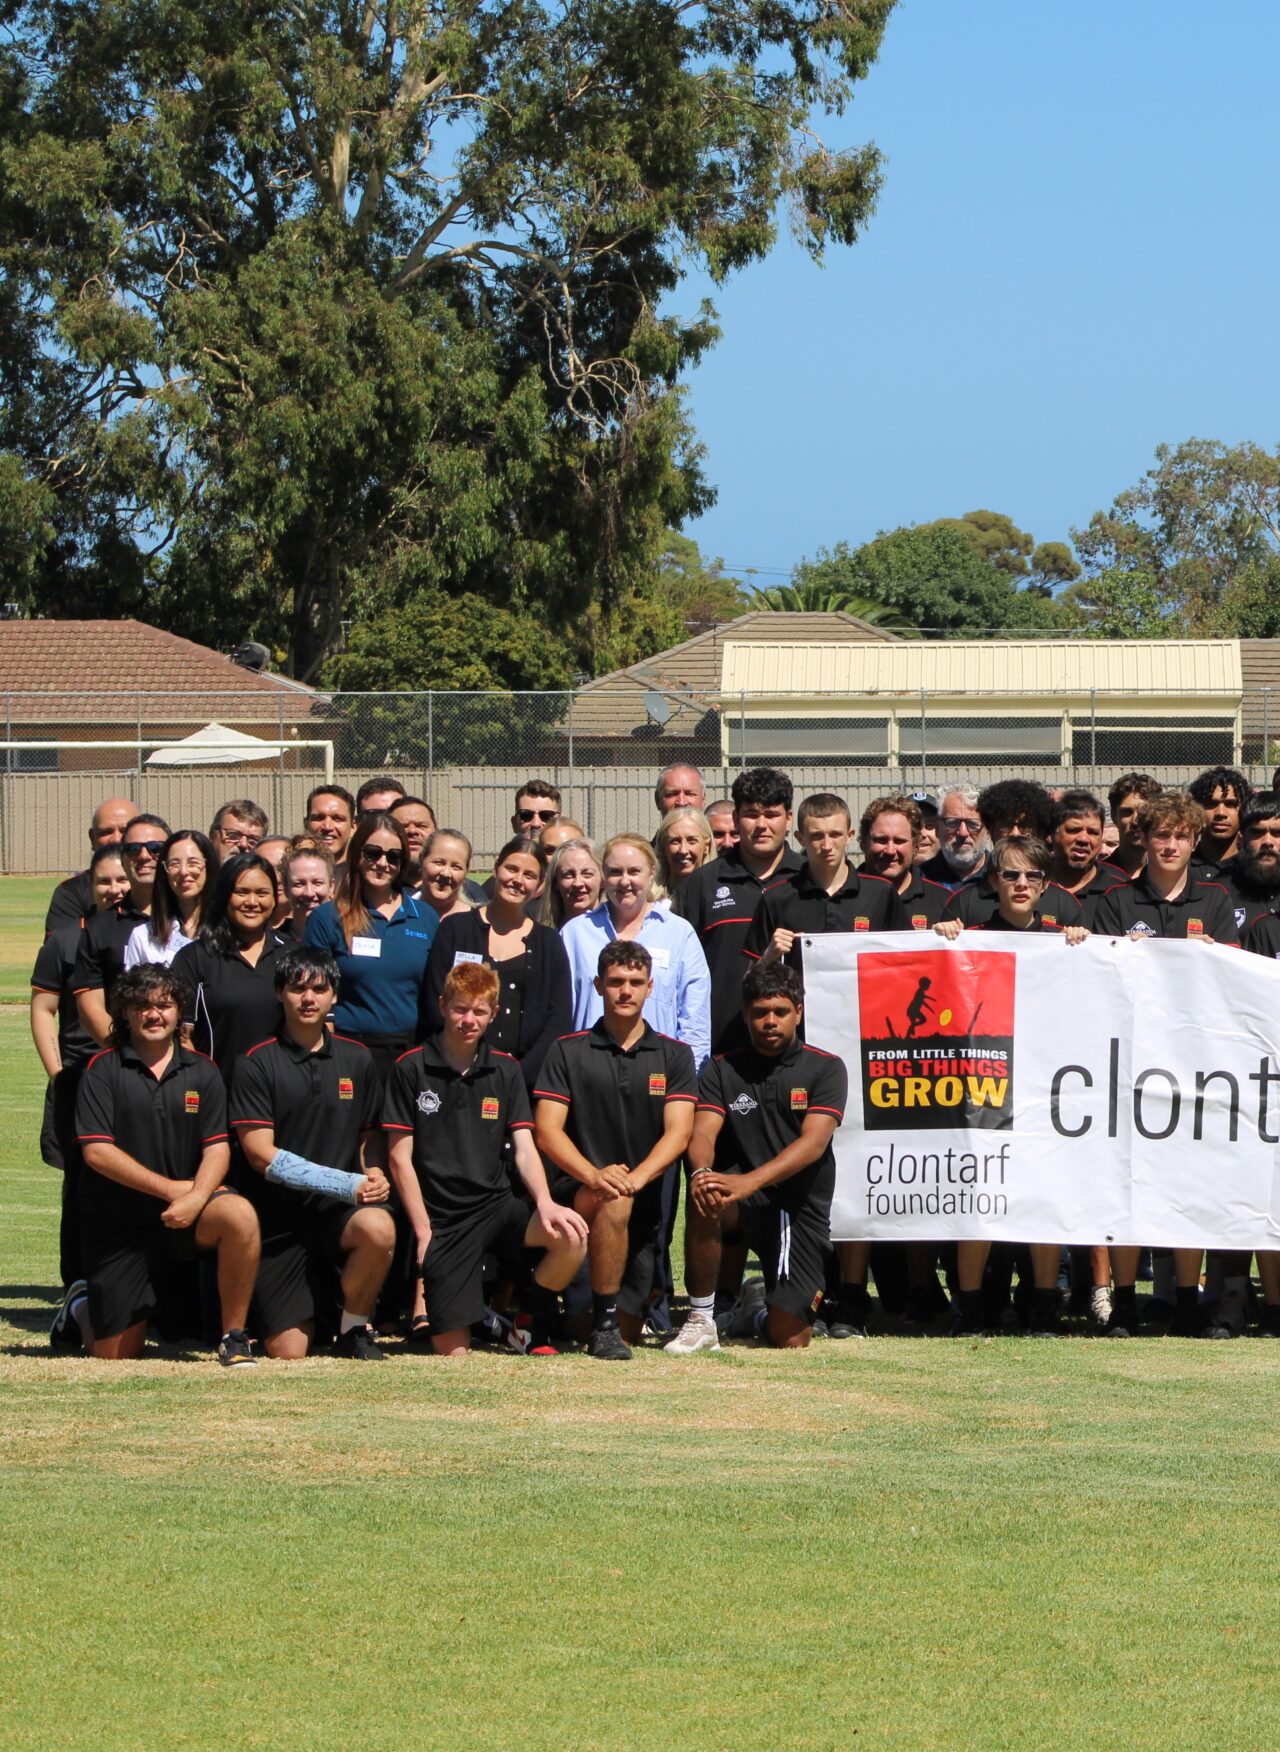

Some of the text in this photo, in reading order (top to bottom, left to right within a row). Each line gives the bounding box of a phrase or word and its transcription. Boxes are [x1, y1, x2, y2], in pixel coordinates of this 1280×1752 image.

[868, 1048, 1008, 1060] FROM LITTLE THINGS
[869, 1059, 1009, 1077] BIG THINGS
[869, 1076, 1009, 1108] GROW
[866, 1143, 1011, 1185] clontarf
[866, 1185, 1008, 1215] foundation
